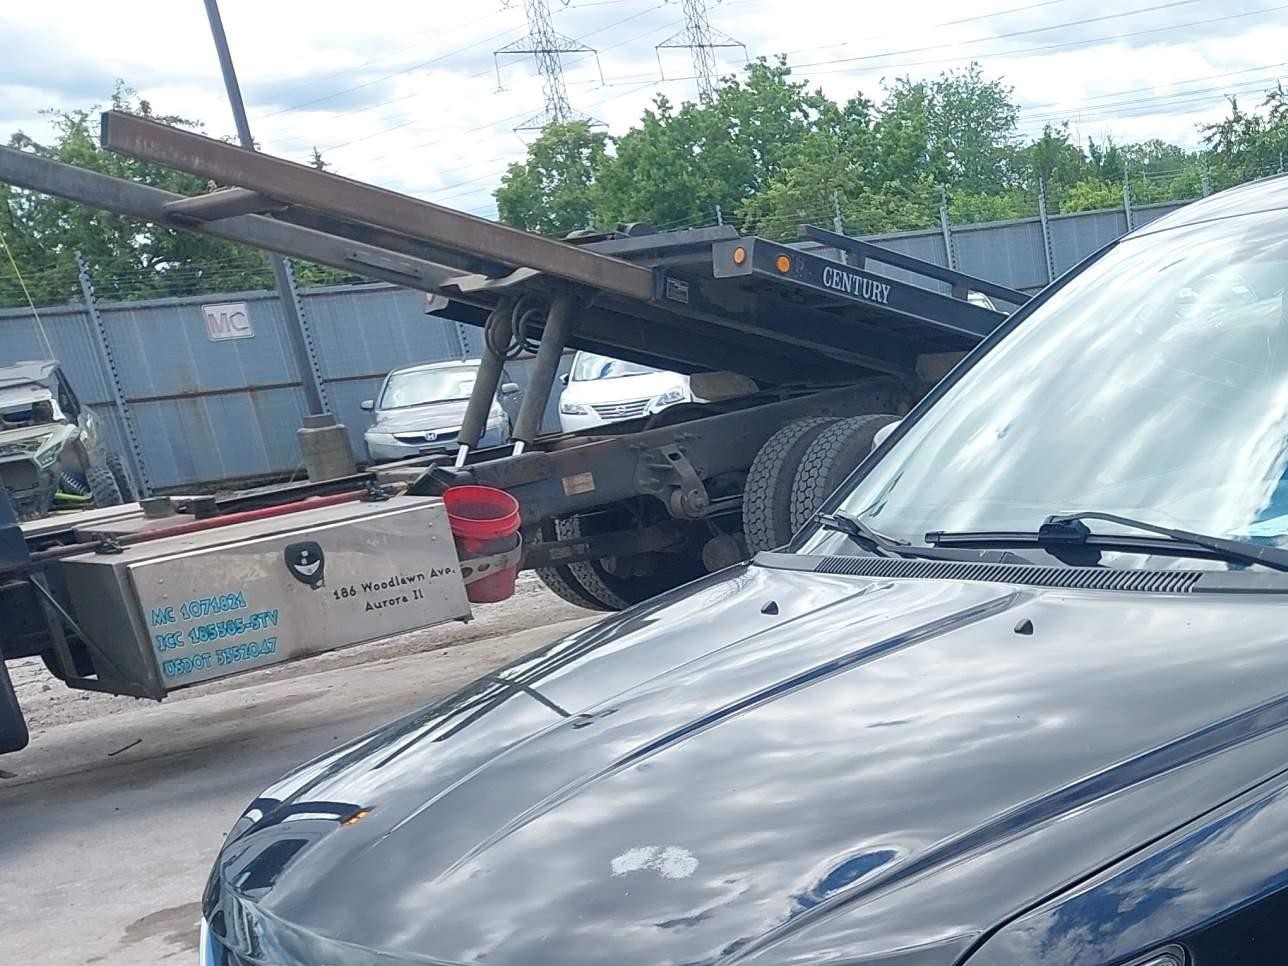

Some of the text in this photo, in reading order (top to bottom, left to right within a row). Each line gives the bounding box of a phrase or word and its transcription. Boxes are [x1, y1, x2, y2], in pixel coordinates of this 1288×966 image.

[823, 266, 891, 304] CENTURY
[207, 311, 249, 334] MC
[333, 567, 456, 600] 186 Woodlawn Ave.
[151, 590, 247, 626] MC 1071821
[365, 595, 409, 612] Aurora
[155, 631, 185, 651] ICC
[162, 652, 212, 676] USDOT
